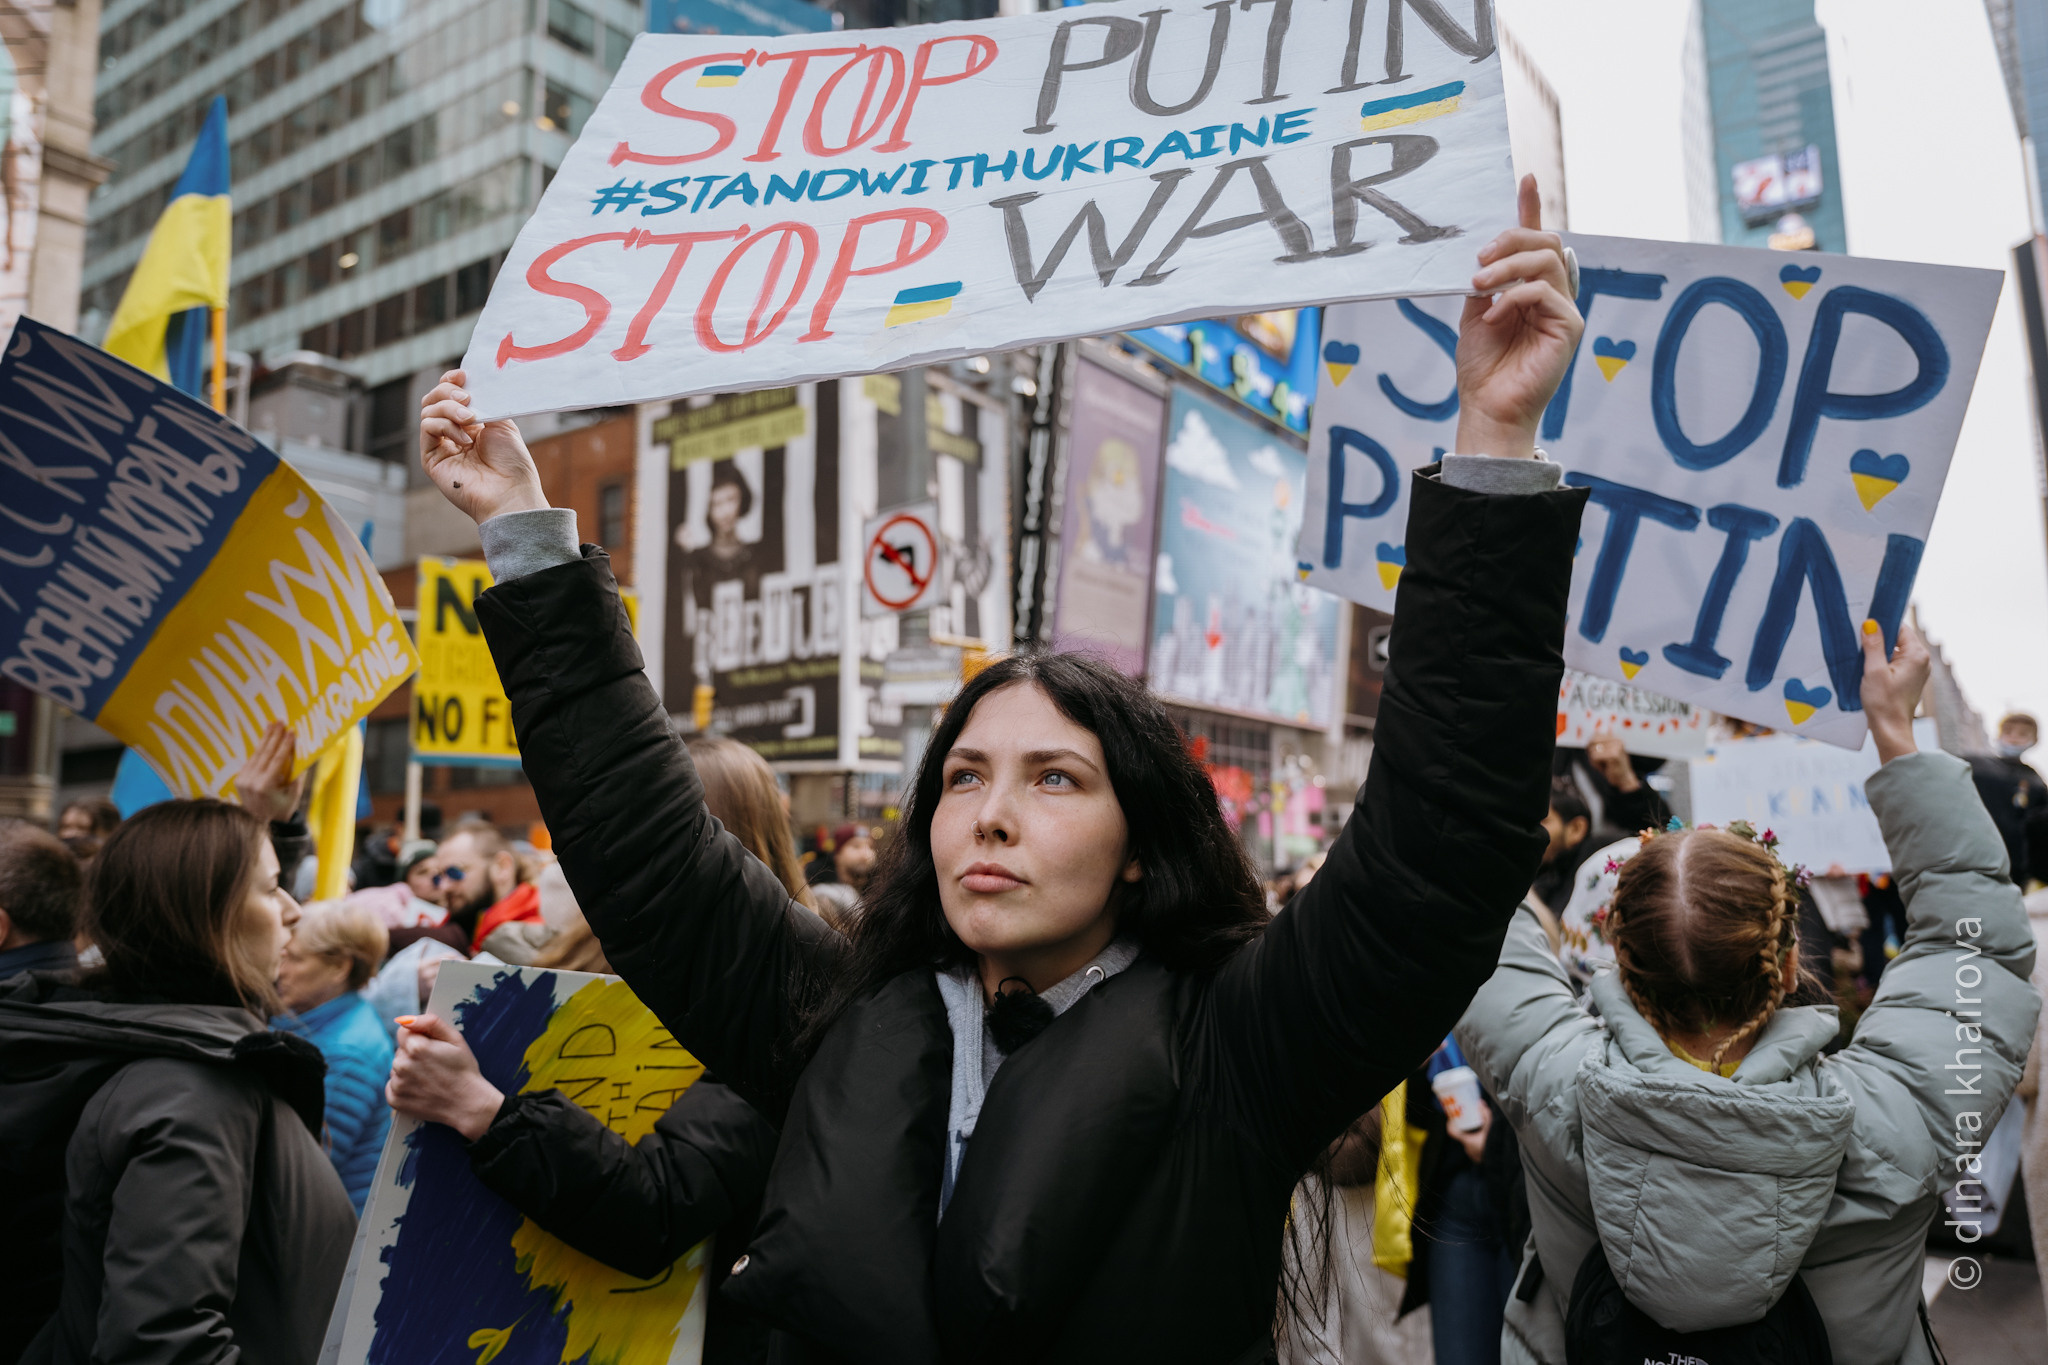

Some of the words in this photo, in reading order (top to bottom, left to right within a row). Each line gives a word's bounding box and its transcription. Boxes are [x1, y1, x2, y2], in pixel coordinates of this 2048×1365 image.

[608, 34, 999, 167] STOP
[1022, 0, 1496, 134] PUTIN
[592, 107, 1318, 216] #STANDWITHUKRAINE
[496, 208, 949, 370] STOP
[989, 134, 1466, 303] WAR
[1323, 425, 1925, 711] PTIN
[416, 695, 463, 743] NO
[481, 697, 518, 748] FL
[1568, 683, 1690, 717] AGGRESSION
[1746, 782, 1869, 819] UKRAIN
